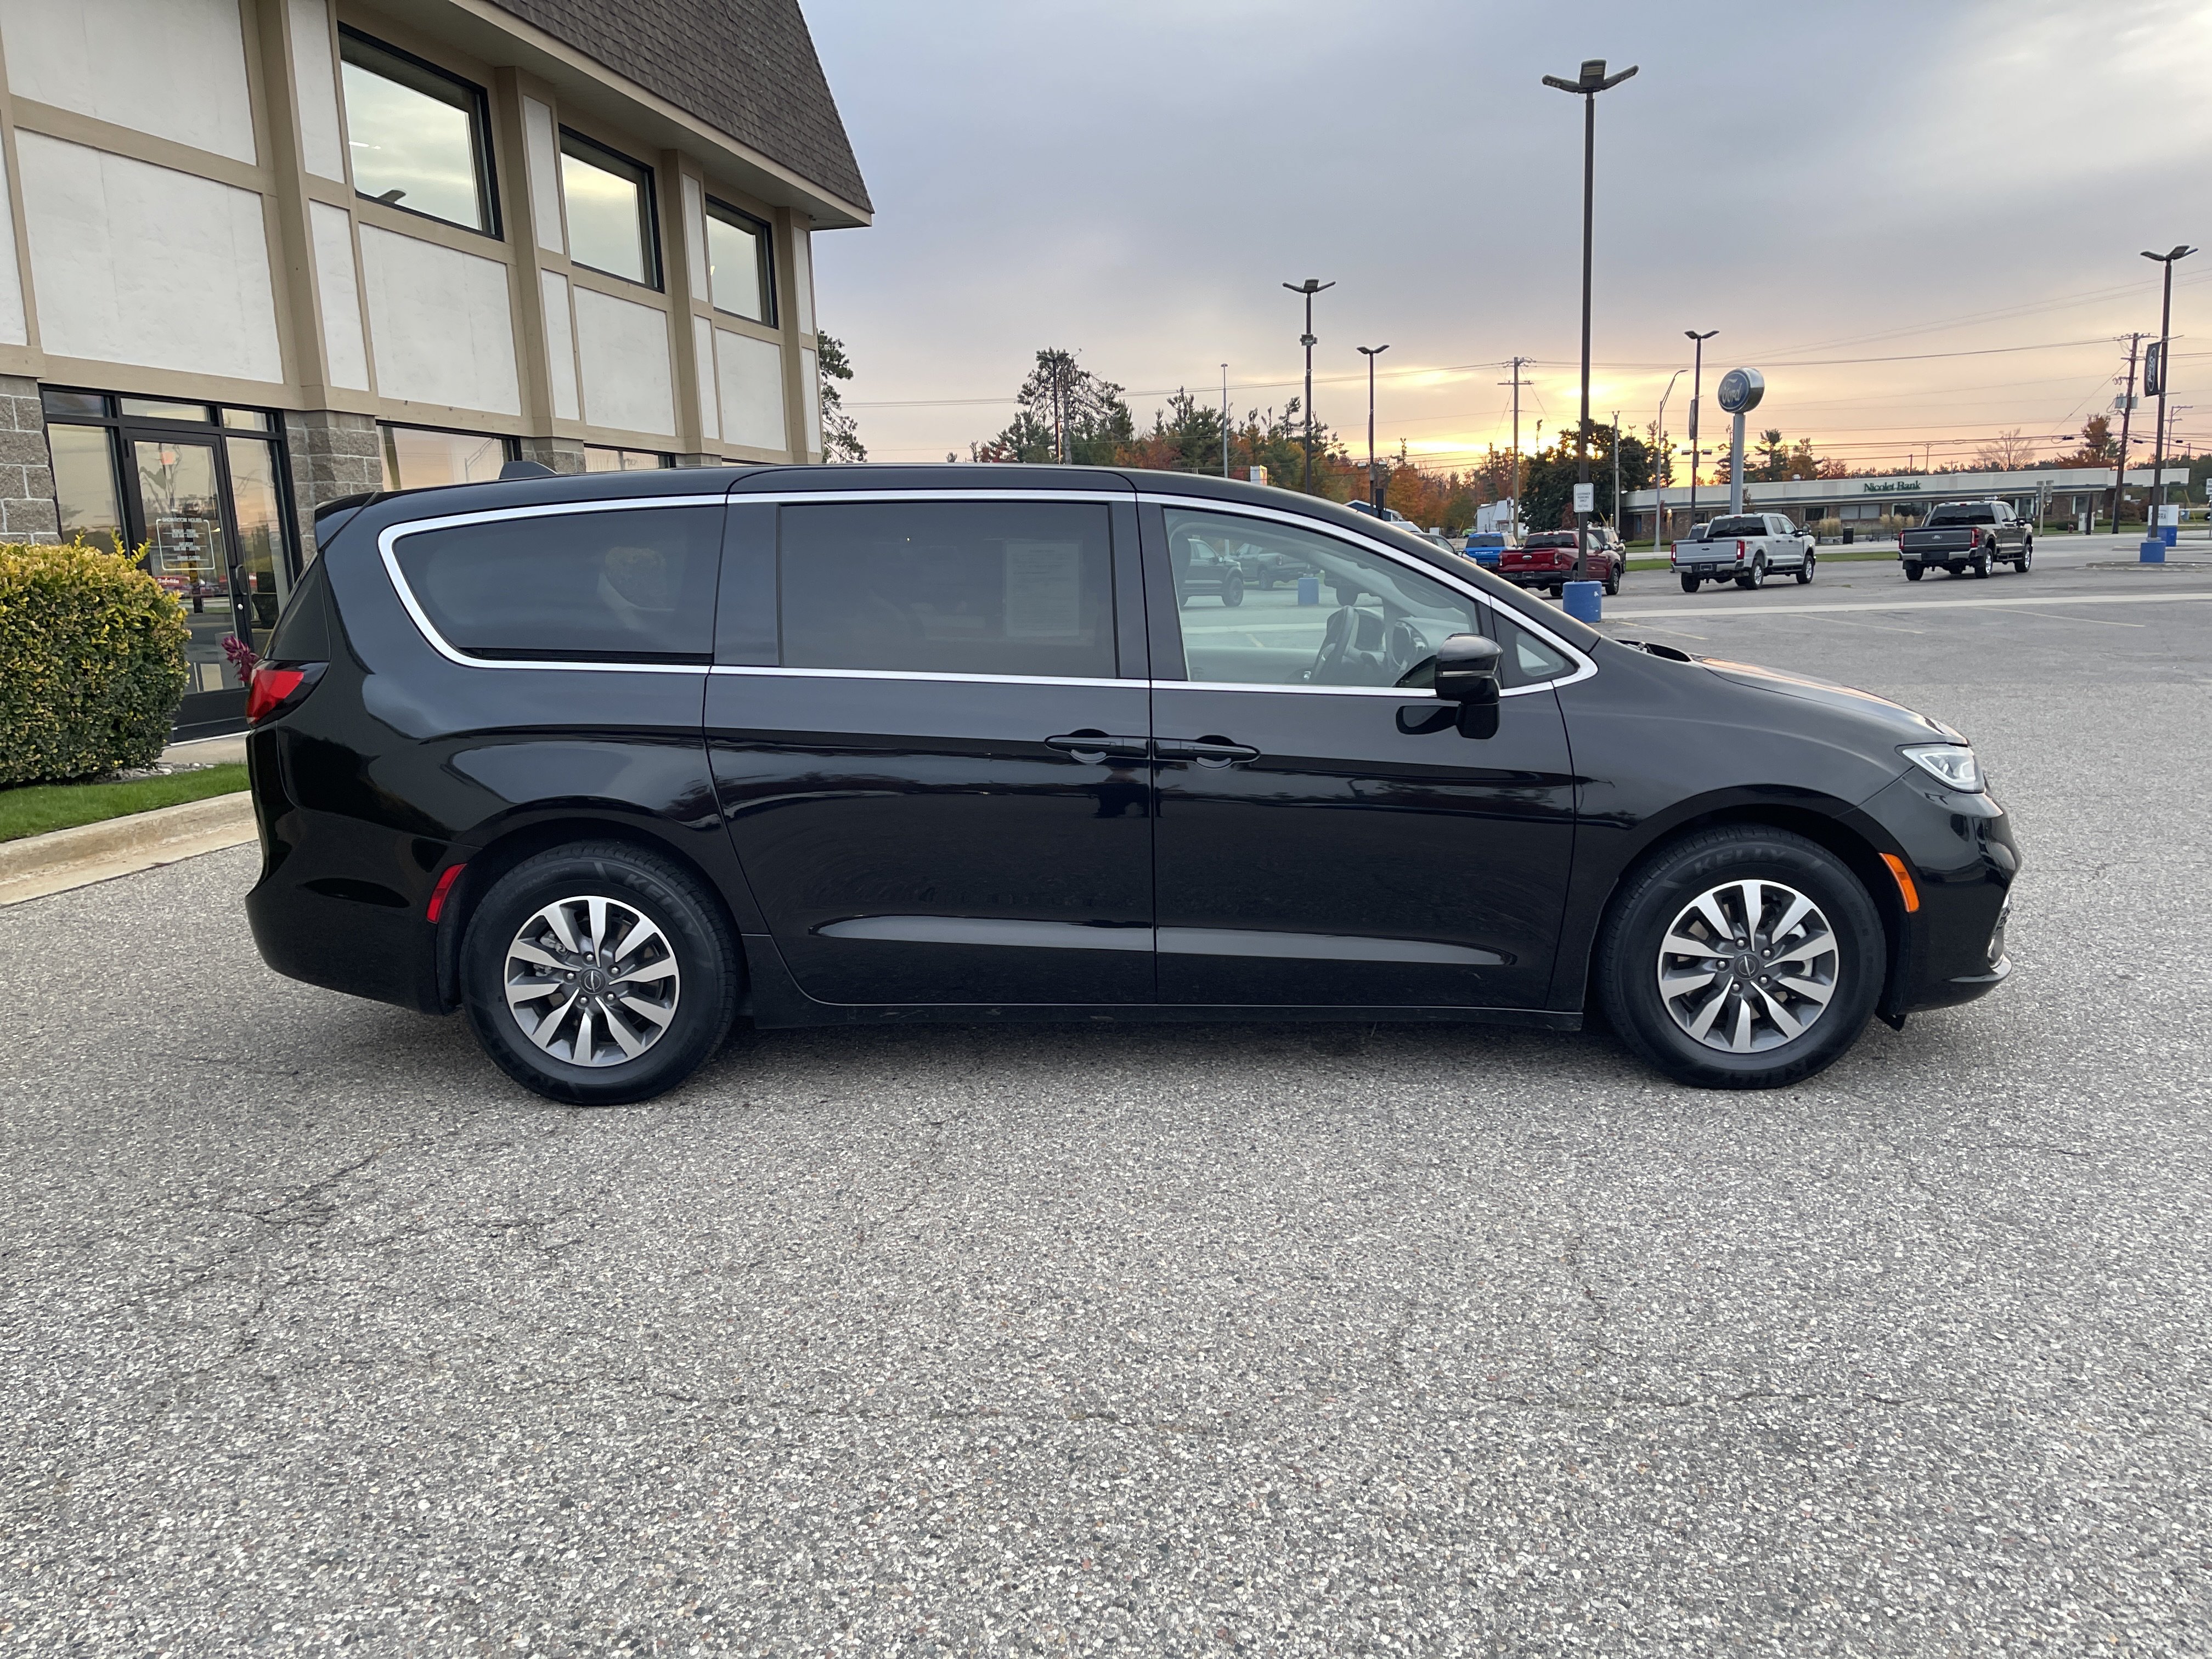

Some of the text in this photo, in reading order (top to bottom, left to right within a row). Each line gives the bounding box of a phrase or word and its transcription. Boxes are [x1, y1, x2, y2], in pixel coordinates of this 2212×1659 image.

[2148, 356, 2156, 383] Ford
[1722, 378, 1743, 404] Ford
[1864, 481, 1921, 492] Nicolet Bank
[1694, 848, 1787, 875] KELLY
[624, 873, 697, 936] KELLY
